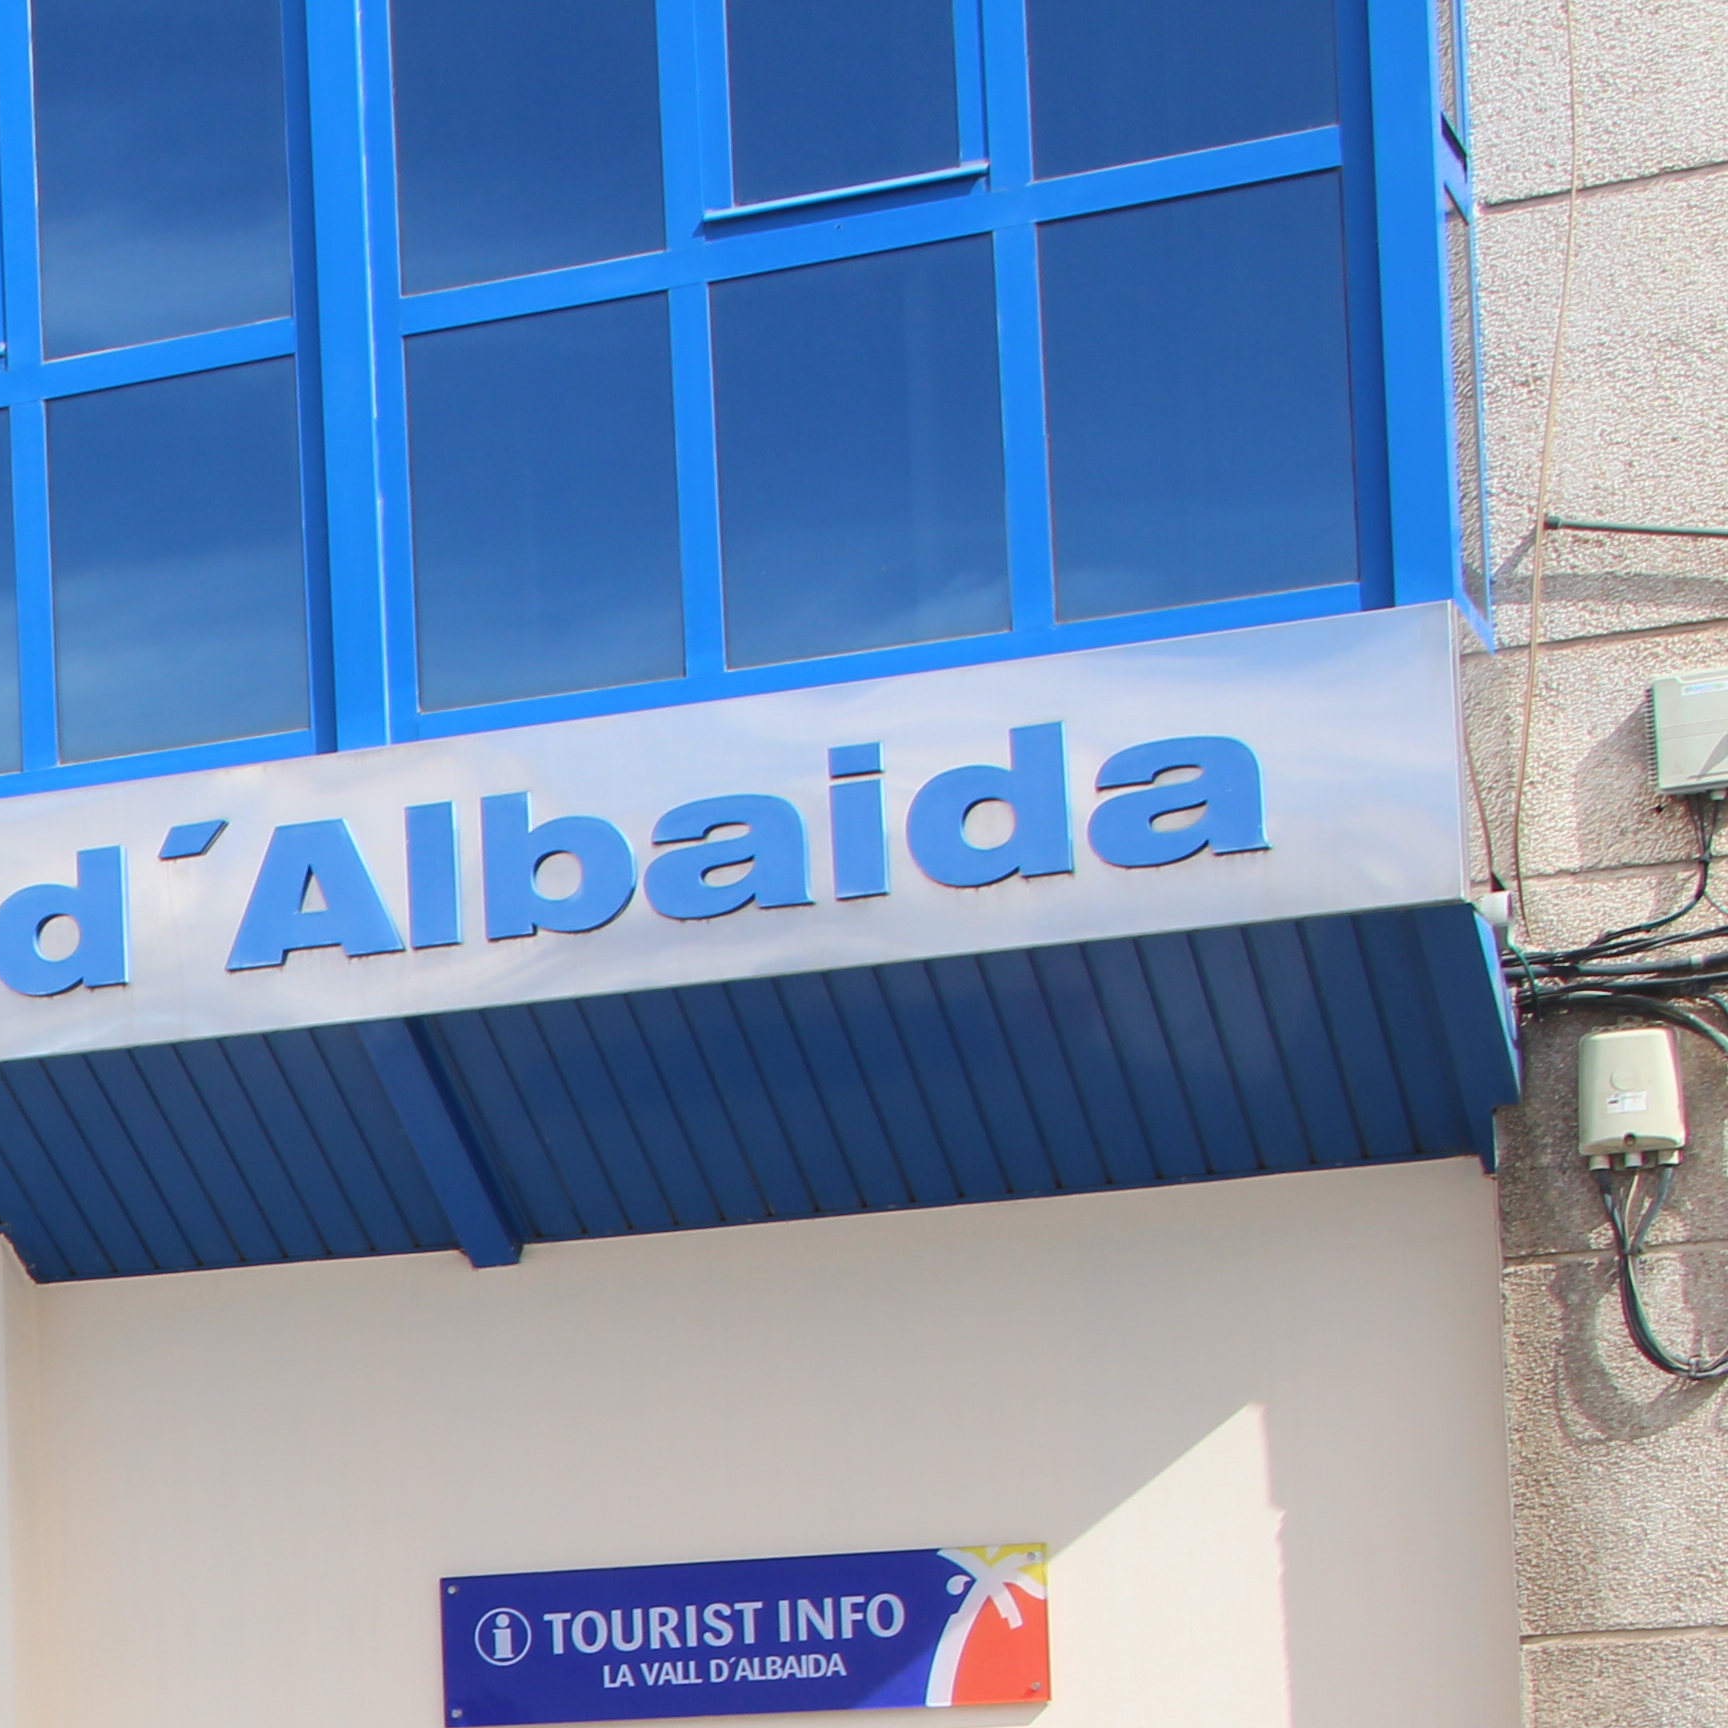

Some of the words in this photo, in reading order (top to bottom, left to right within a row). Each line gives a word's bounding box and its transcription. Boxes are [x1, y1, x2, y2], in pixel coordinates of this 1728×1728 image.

[544, 1600, 763, 1656] TOURIST
[779, 1592, 905, 1643] INFO
[602, 1662, 635, 1688] LA
[640, 1658, 703, 1686] VALL
